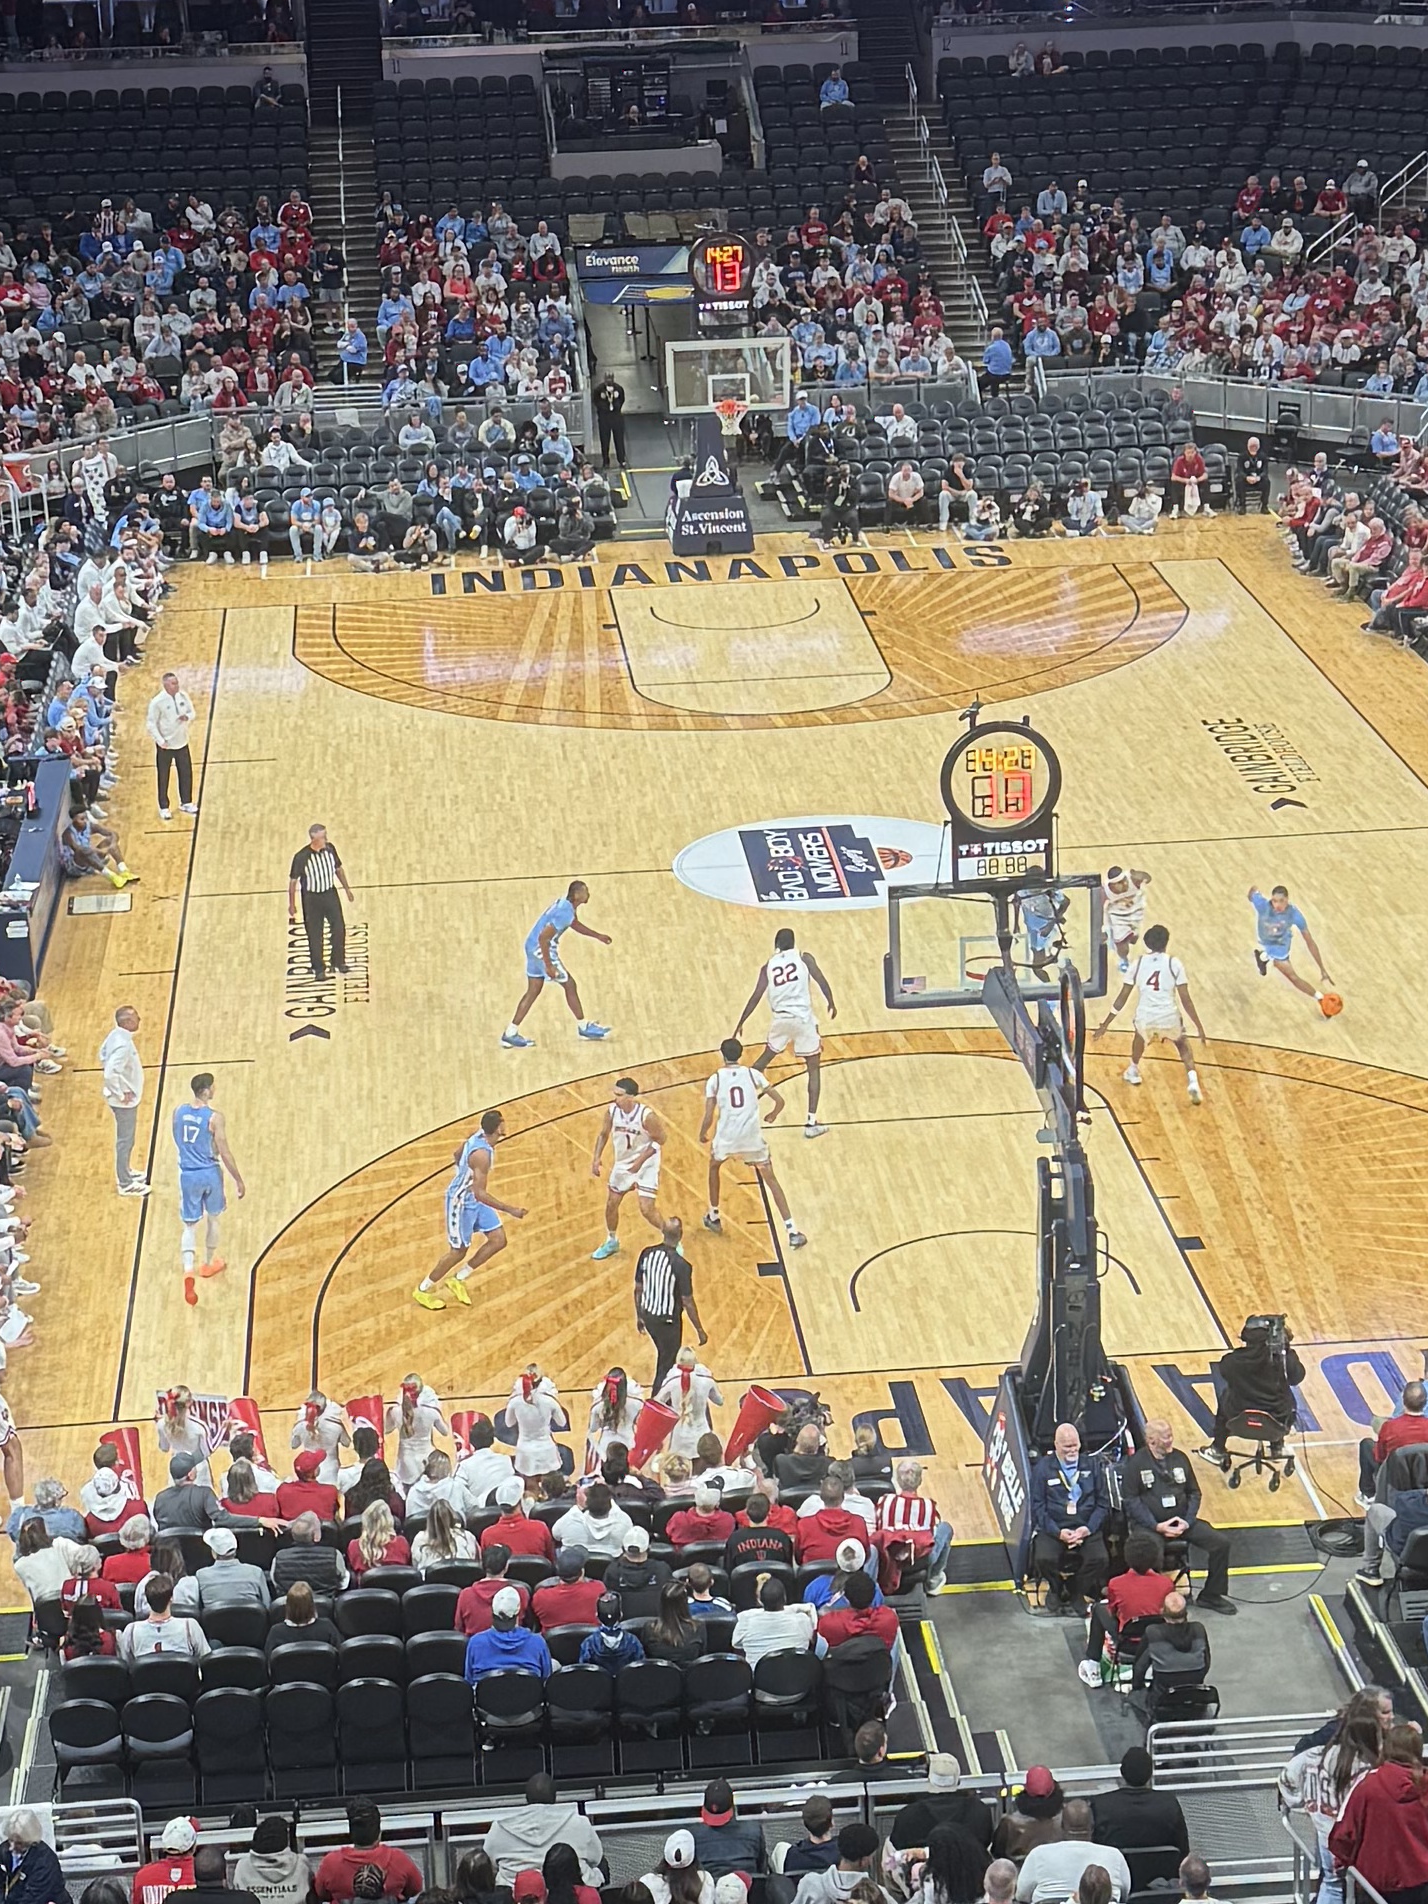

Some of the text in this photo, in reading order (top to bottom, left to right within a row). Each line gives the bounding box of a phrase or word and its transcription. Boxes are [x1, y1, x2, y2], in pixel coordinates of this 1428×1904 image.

[706, 245, 743, 264] 14:27
[715, 261, 741, 291] 13
[713, 299, 750, 311] TISSOT
[681, 507, 744, 523] Ascension
[431, 543, 1014, 595] INDIANAPOLIS
[1200, 716, 1297, 795] GAINBRIDGE
[983, 838, 1049, 856] TISSOT
[767, 829, 810, 903] BAD BOY
[800, 830, 842, 895] MOWERS
[772, 962, 800, 988] 22
[1146, 970, 1161, 992] 4
[730, 1085, 745, 1109] 0
[183, 1124, 200, 1144] 17
[625, 1133, 632, 1150] 1
[736, 1537, 783, 1554] INDIANA
